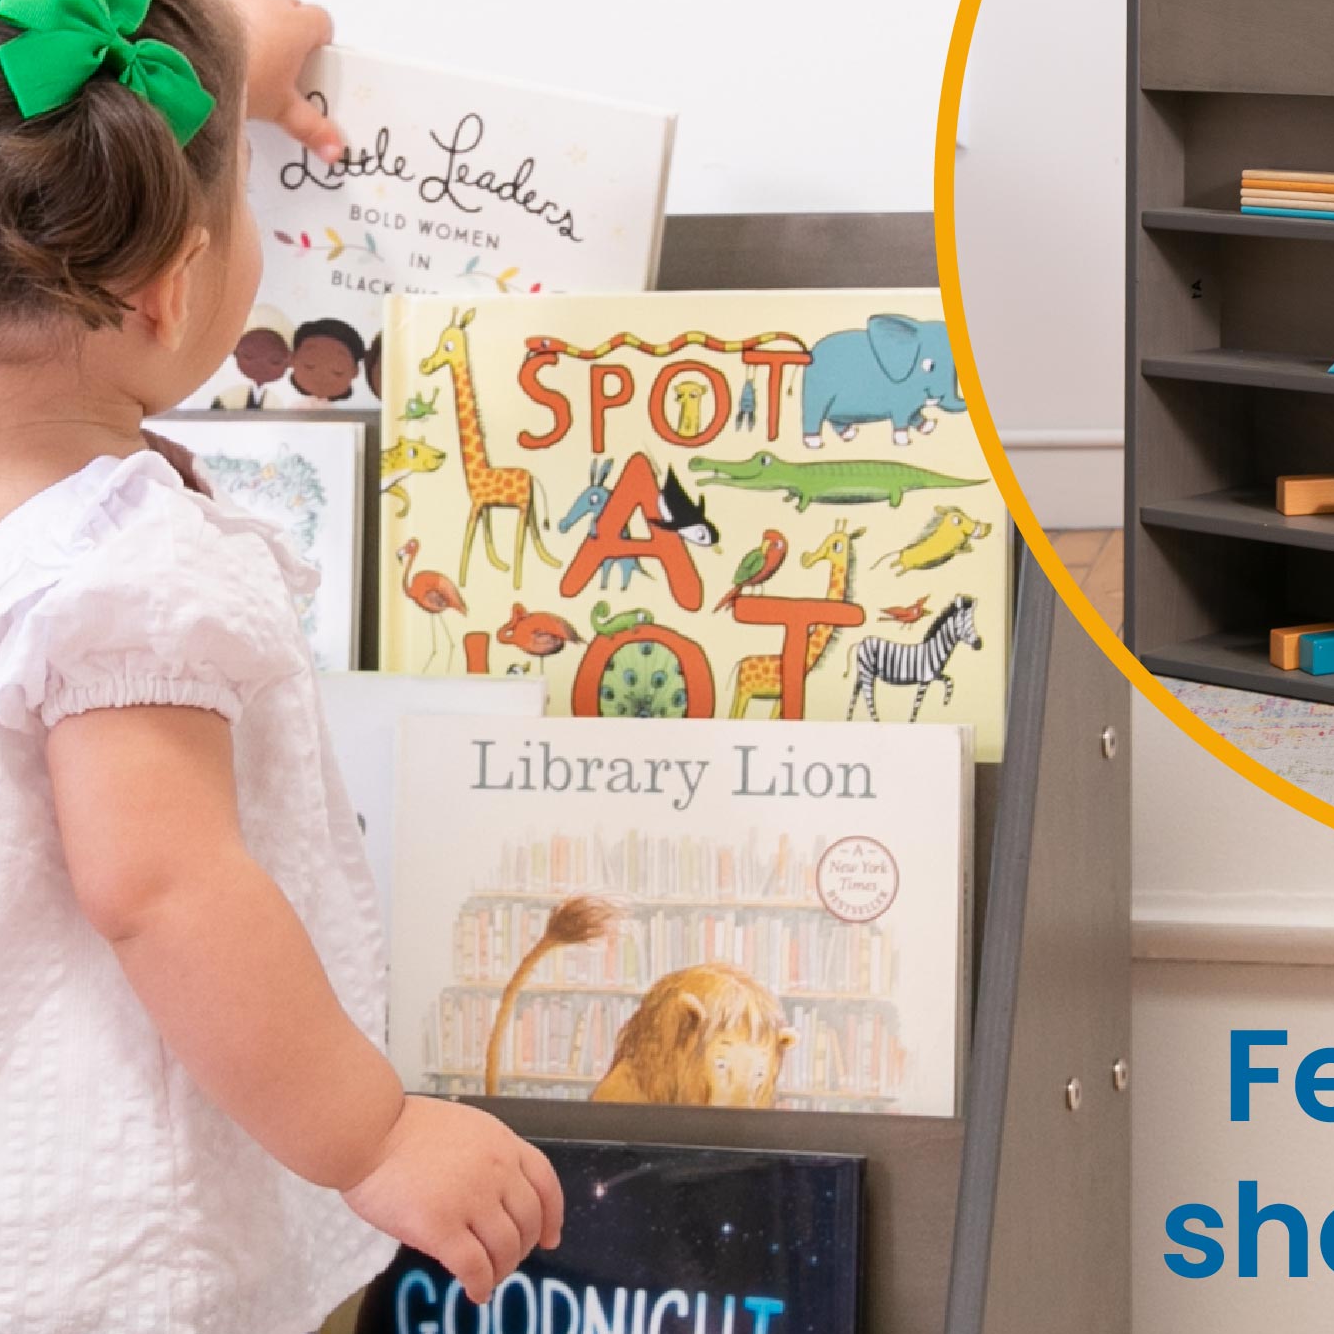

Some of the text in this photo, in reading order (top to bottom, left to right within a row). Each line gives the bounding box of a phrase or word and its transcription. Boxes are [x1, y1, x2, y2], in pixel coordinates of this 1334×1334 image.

[280, 91, 582, 241] Little Leaders
[349, 204, 501, 250] BOLD WOMEN
[409, 252, 431, 271] IN
[331, 270, 395, 295] BLACK
[517, 349, 813, 453] SPOT
[559, 451, 704, 612] A
[470, 739, 877, 810] Library Lion
